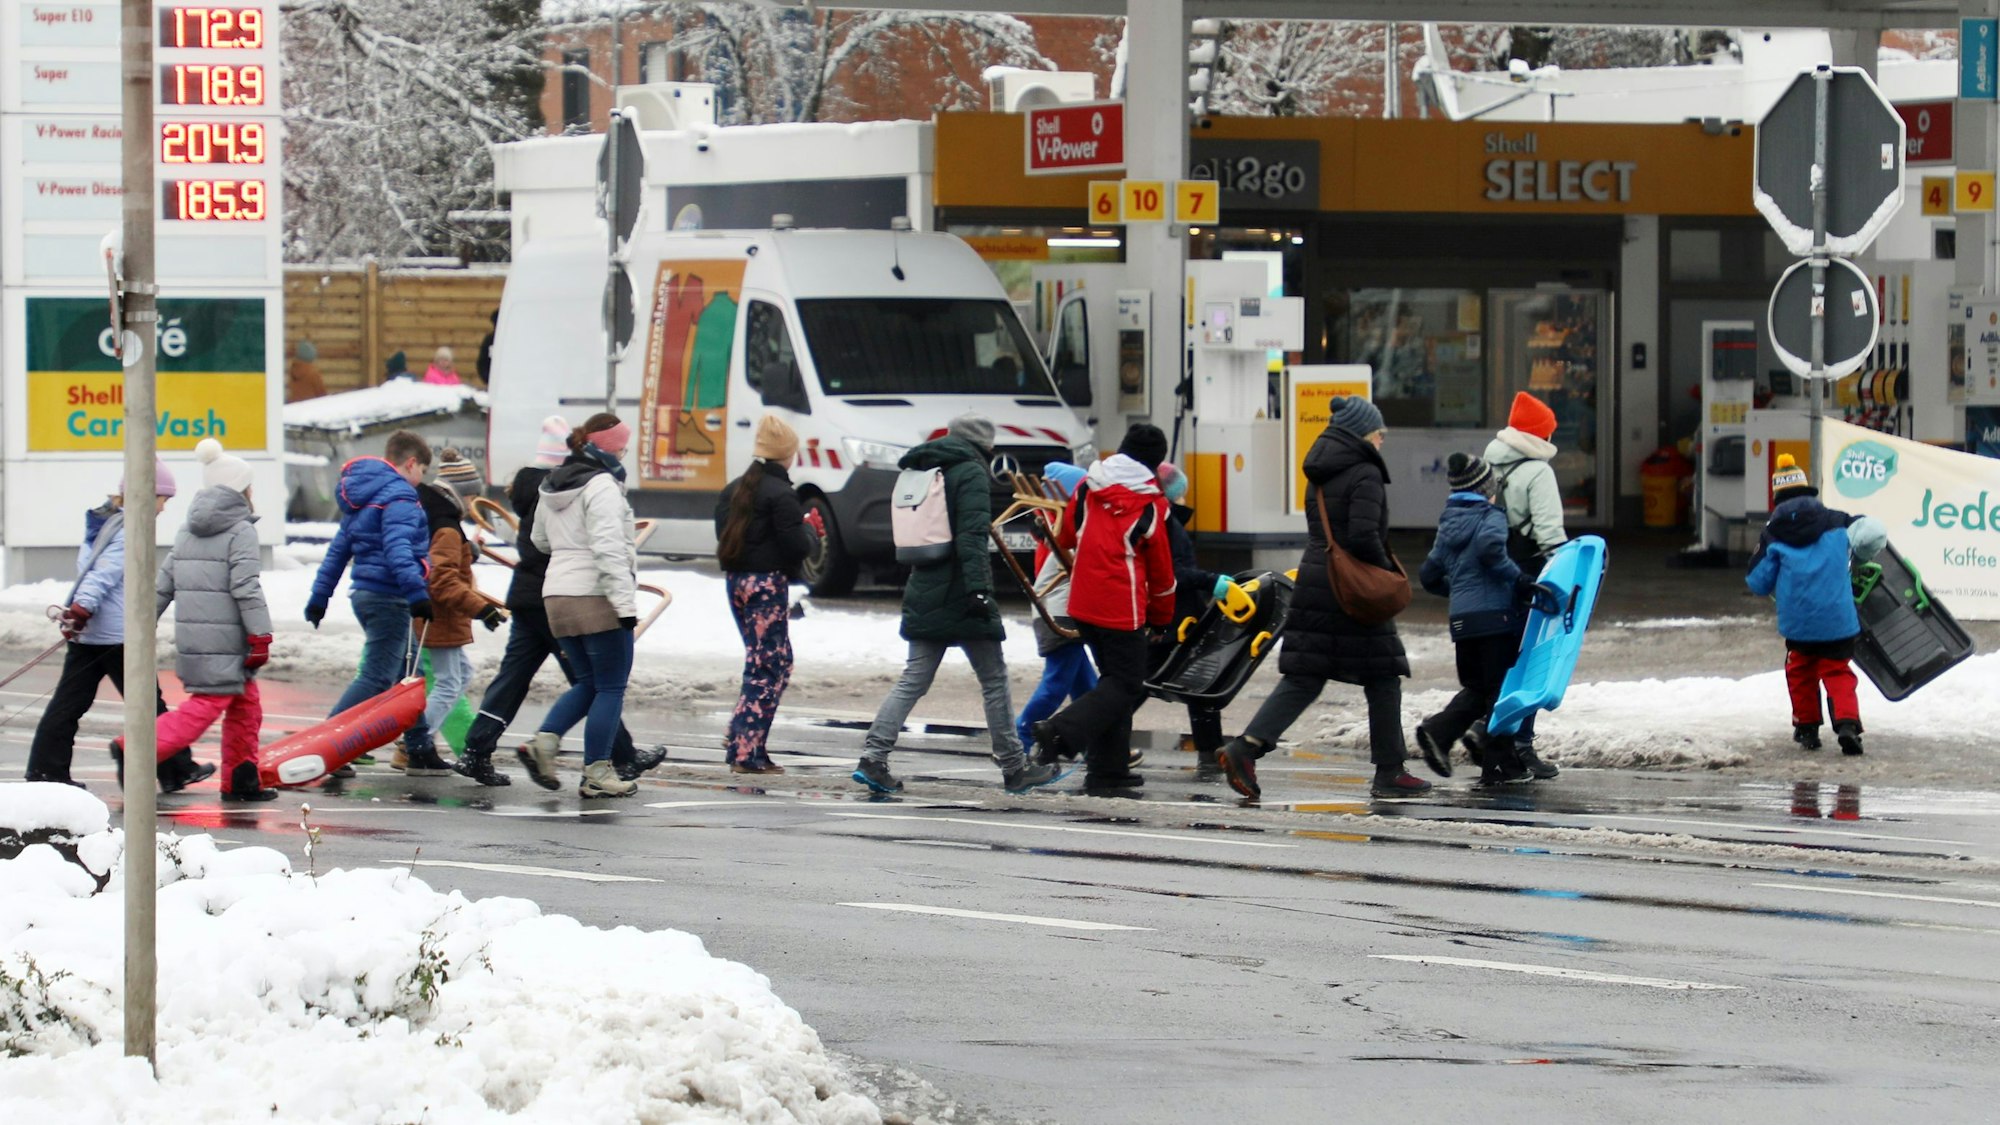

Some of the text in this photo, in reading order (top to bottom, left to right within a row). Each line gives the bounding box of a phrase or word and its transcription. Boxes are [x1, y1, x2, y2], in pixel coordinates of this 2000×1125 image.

[33, 9, 93, 25] Super E10
[174, 8, 262, 48] 172.9
[34, 66, 68, 82] Super
[175, 65, 263, 105] 178.9
[36, 125, 123, 138] V-Power Racin
[1036, 115, 1060, 136] Shell
[162, 123, 263, 163] 204.9
[1037, 138, 1098, 161] V-Power
[1485, 132, 1537, 153] Shell
[1190, 156, 1306, 198] eli2go
[1485, 159, 1638, 202] SELECT
[37, 181, 128, 196] V-Power Diese
[1928, 186, 1942, 207] 4
[1968, 181, 1982, 203] 9
[176, 181, 264, 220] 185.9
[1097, 193, 1112, 215] 6
[1133, 189, 1158, 212] 10
[1189, 192, 1204, 214] 7
[67, 385, 123, 405] Shell
[67, 410, 123, 437] Car
[1841, 455, 1887, 481] café
[1943, 548, 1997, 568] Kaffee
